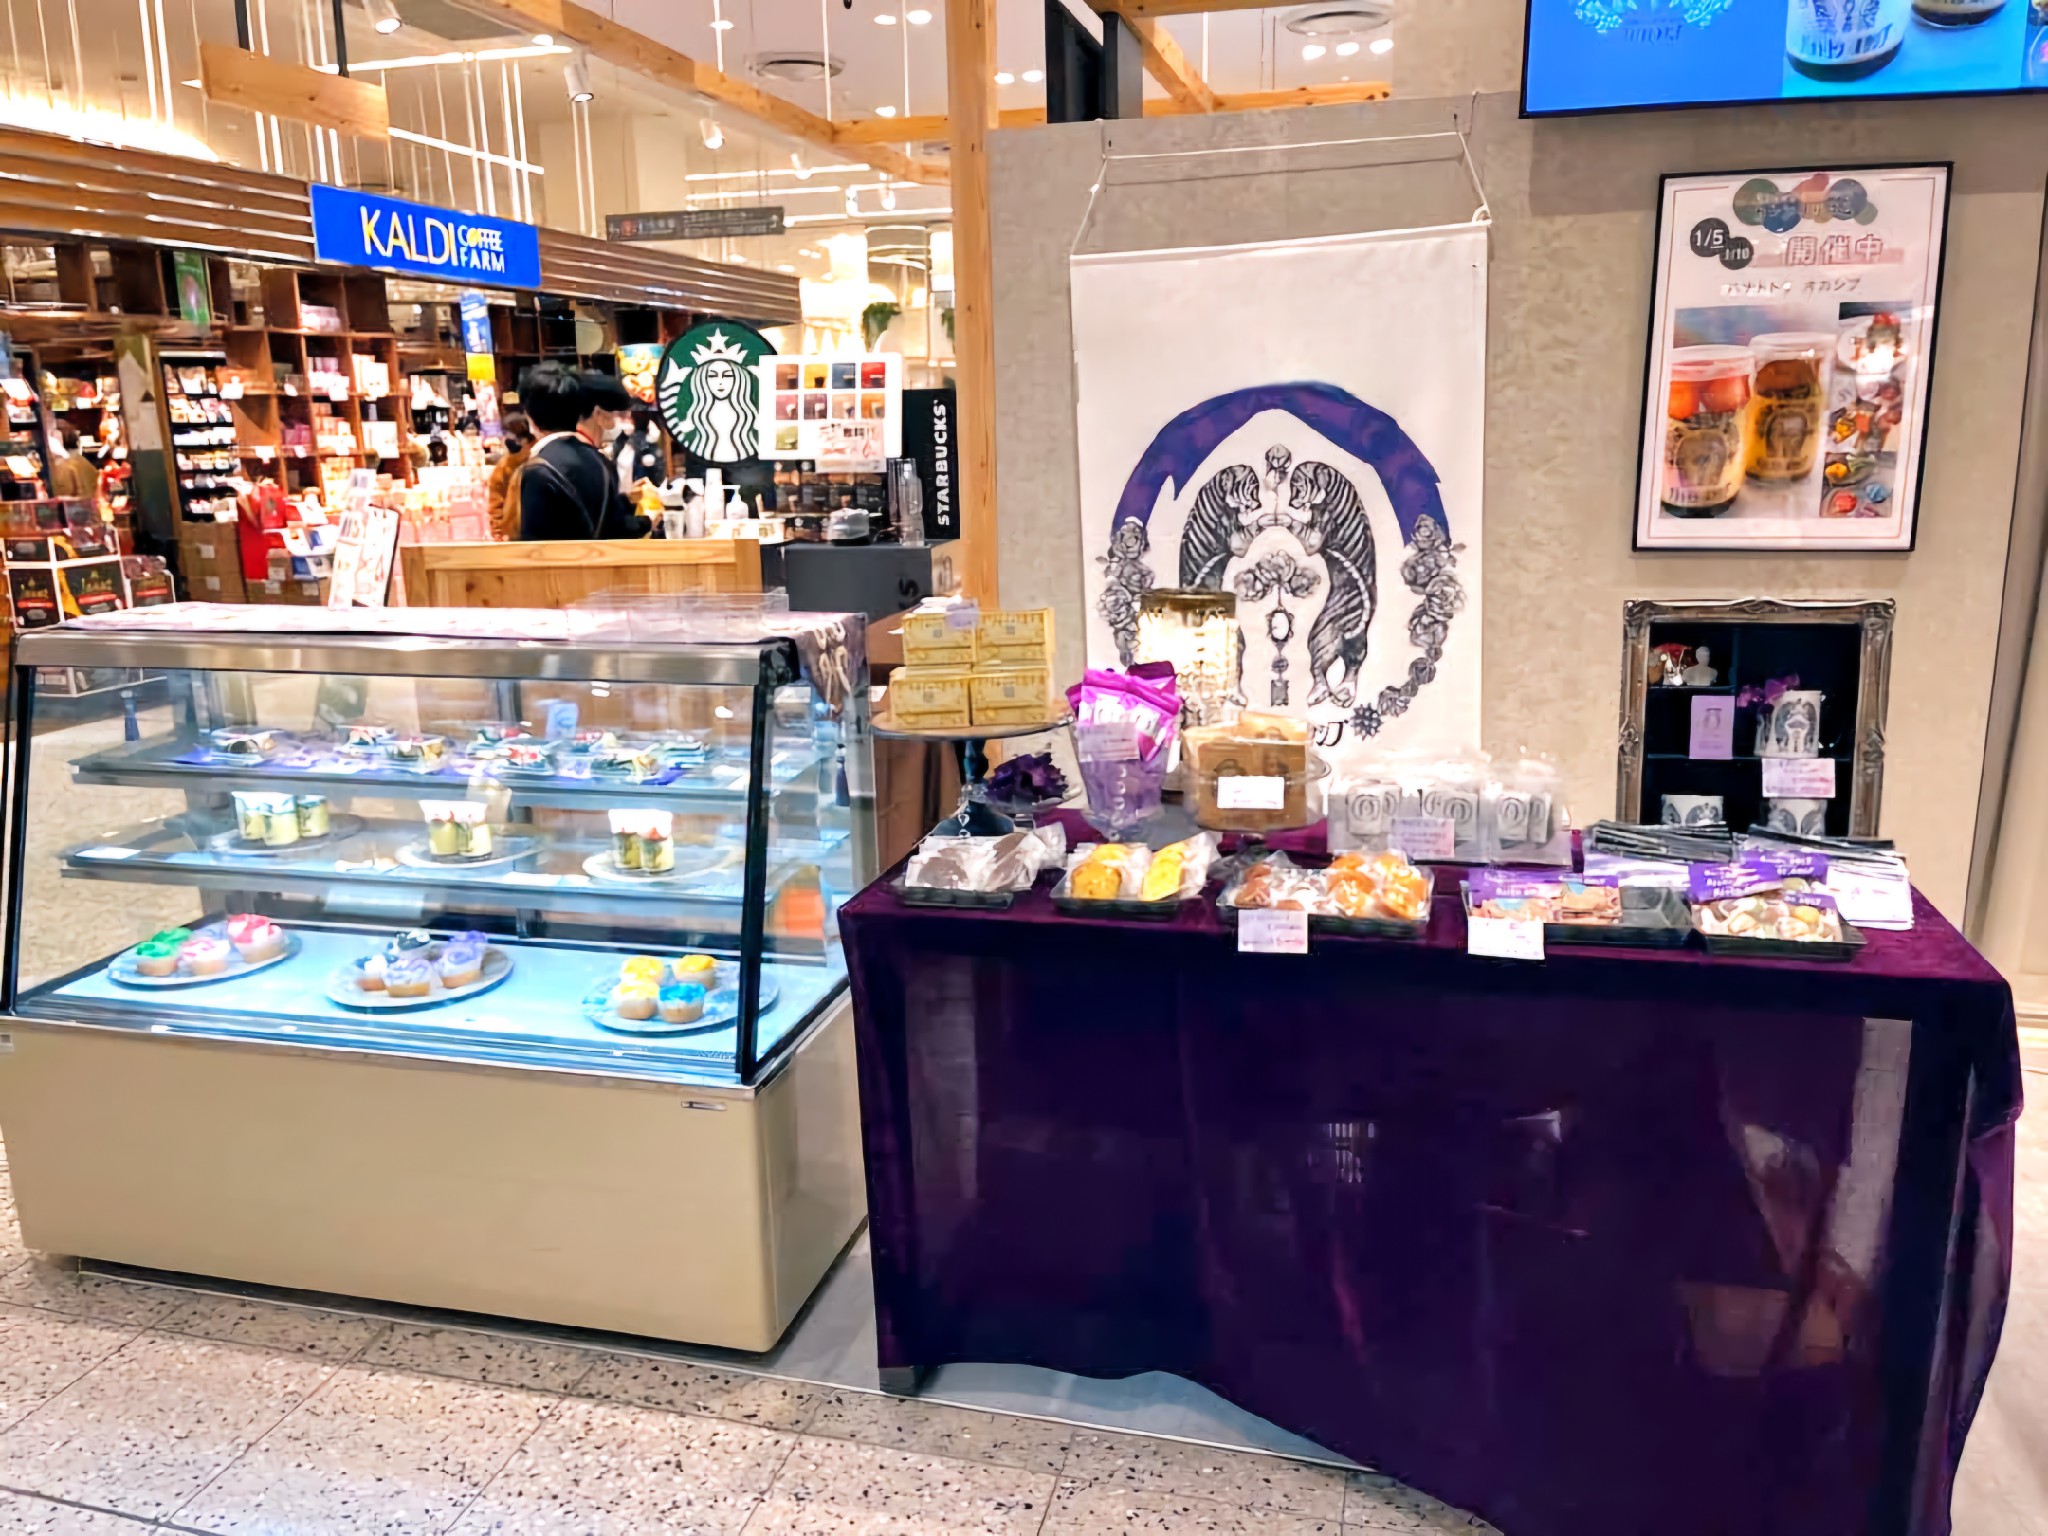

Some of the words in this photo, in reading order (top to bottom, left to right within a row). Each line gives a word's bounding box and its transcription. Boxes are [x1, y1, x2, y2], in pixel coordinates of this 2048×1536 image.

[360, 205, 459, 266] KALDI
[457, 225, 504, 252] COFFEE
[1786, 233, 1884, 266] 開催中
[459, 247, 505, 273] FARM
[933, 402, 950, 526] STARBUCKS
